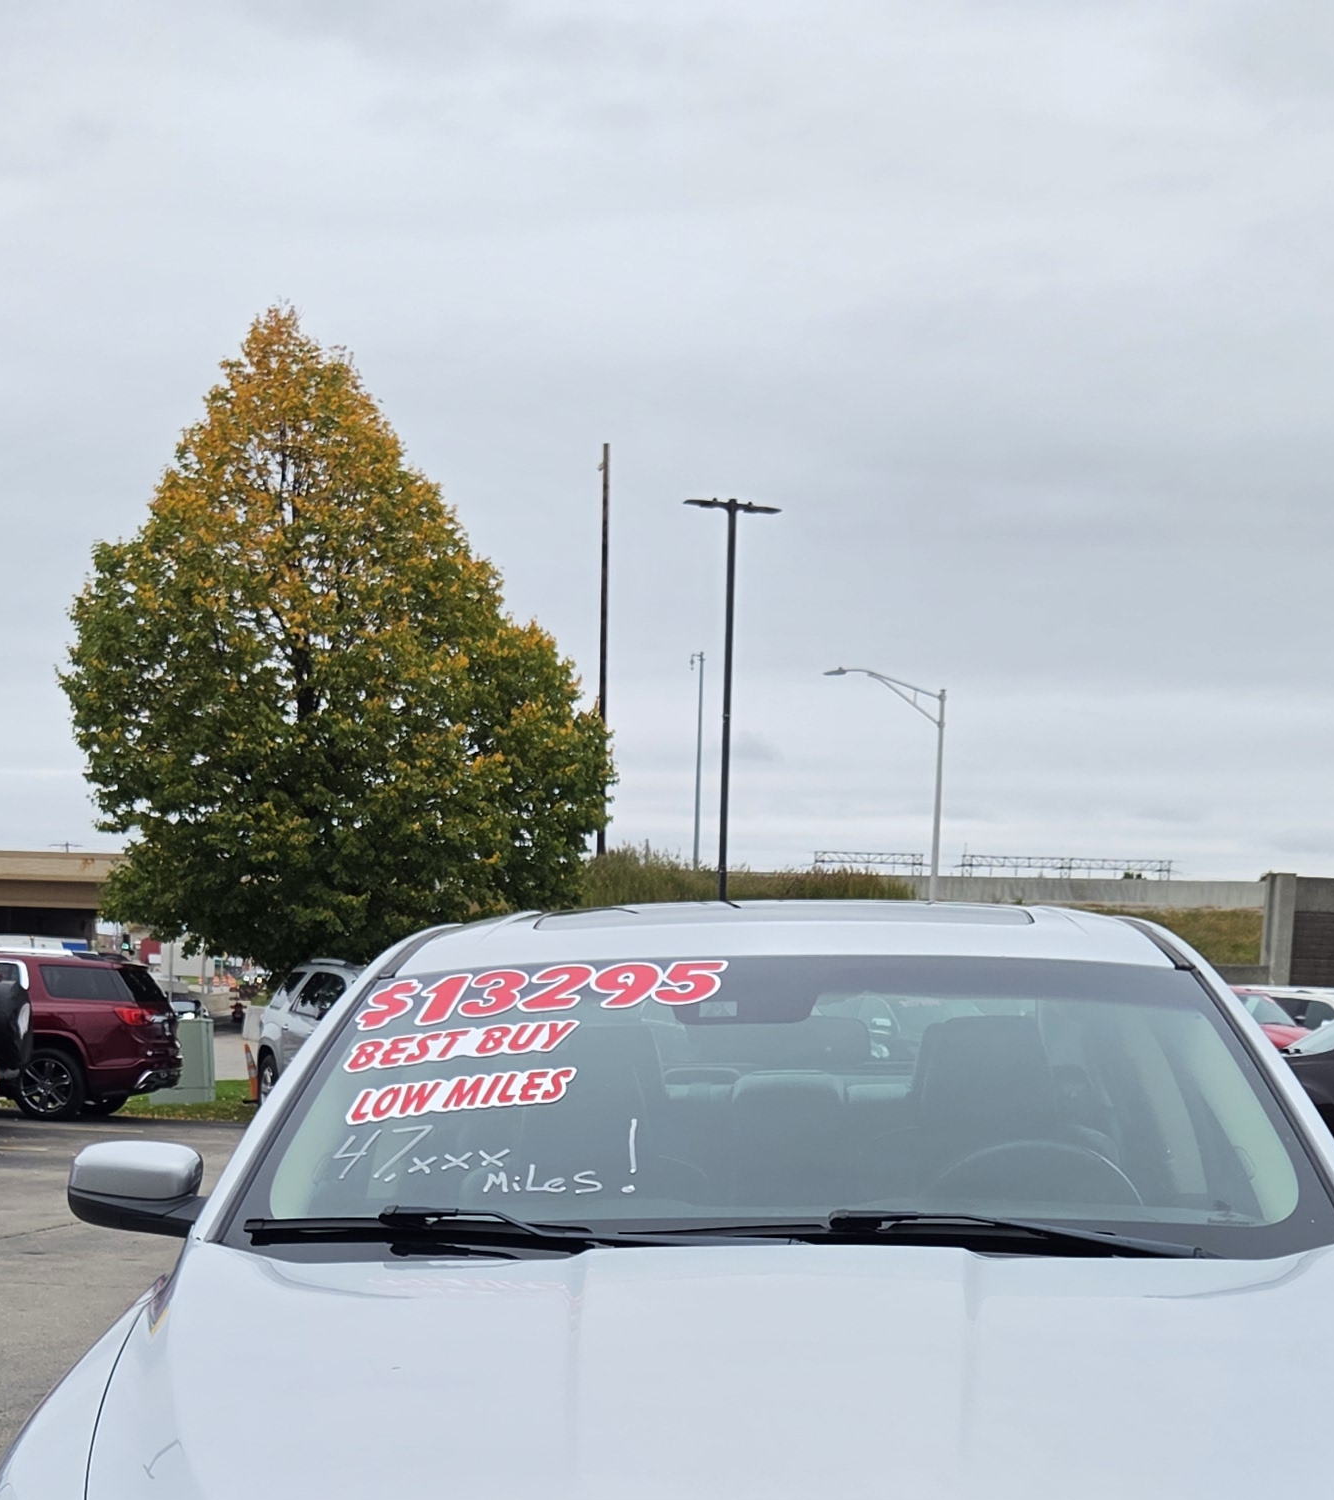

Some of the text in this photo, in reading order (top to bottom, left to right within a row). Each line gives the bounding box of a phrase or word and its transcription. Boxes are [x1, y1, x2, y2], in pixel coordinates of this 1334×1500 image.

[355, 960, 728, 1030] $13295
[345, 1021, 578, 1072] BEST BUY
[348, 1068, 575, 1123] LOW MILES
